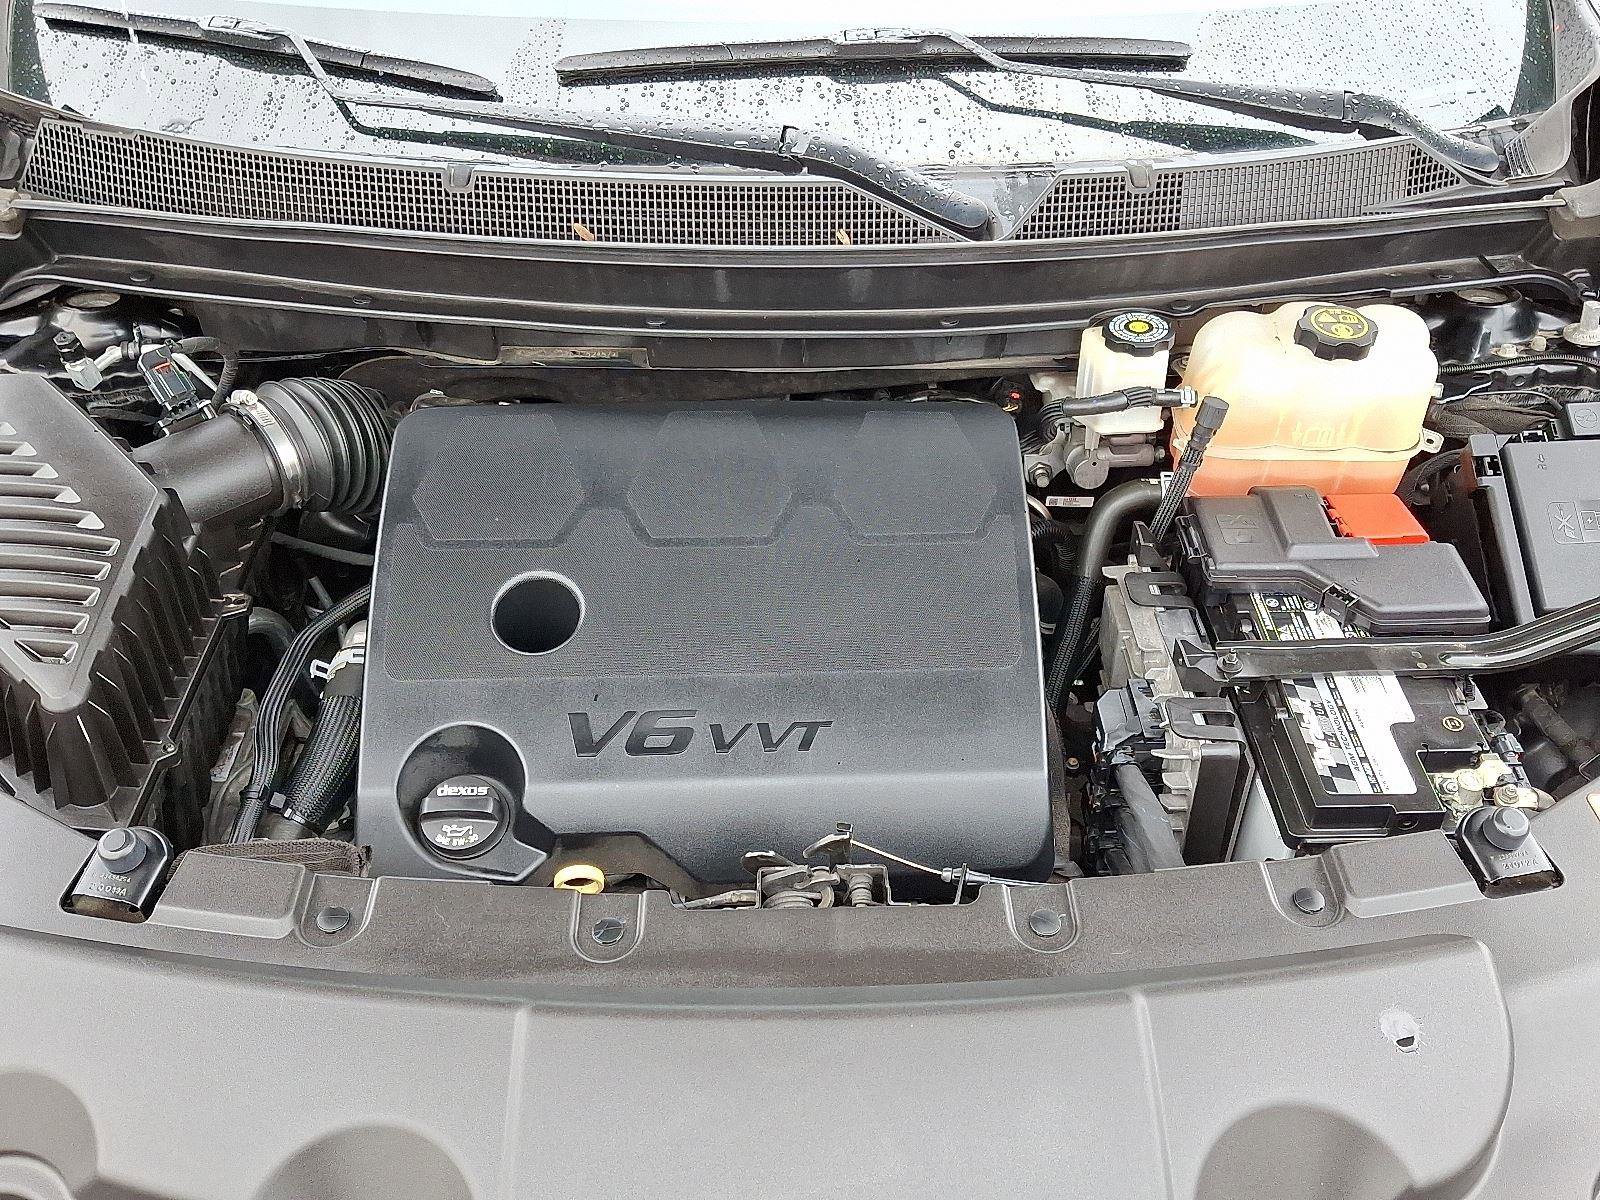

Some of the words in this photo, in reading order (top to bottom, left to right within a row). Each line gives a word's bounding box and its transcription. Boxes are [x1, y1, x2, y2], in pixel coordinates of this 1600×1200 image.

[568, 710, 698, 757] V6
[709, 721, 833, 753] VVT
[1325, 698, 1351, 750] TECHNOLOGY
[1349, 752, 1361, 772] AGM
[437, 785, 490, 797] dexos
